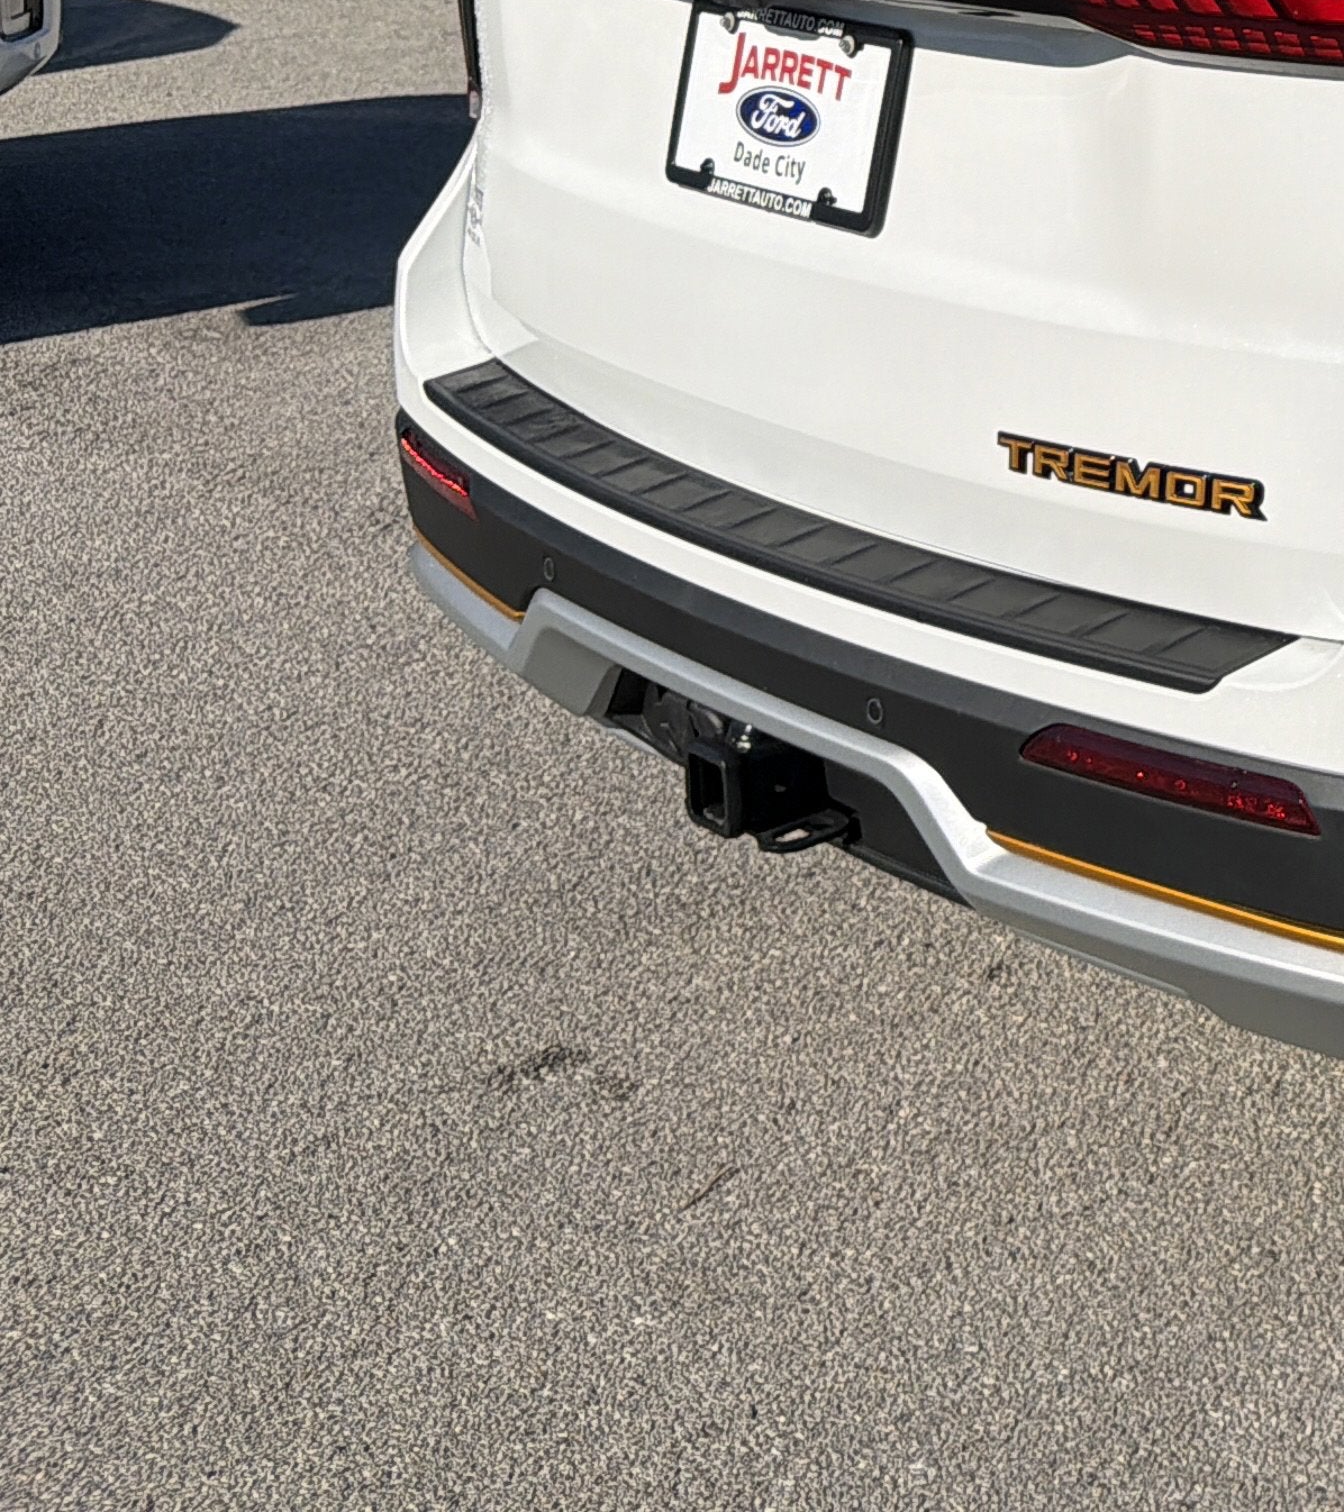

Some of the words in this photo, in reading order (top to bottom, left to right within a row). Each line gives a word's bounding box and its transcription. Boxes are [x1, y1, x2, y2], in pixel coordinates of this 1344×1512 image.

[717, 32, 852, 101] JARRETT
[750, 93, 806, 139] Ford
[733, 141, 770, 175] Dade
[774, 151, 806, 185] City
[707, 177, 812, 218] JARRETTAUTO.COM
[997, 430, 1268, 522] TREMOR
